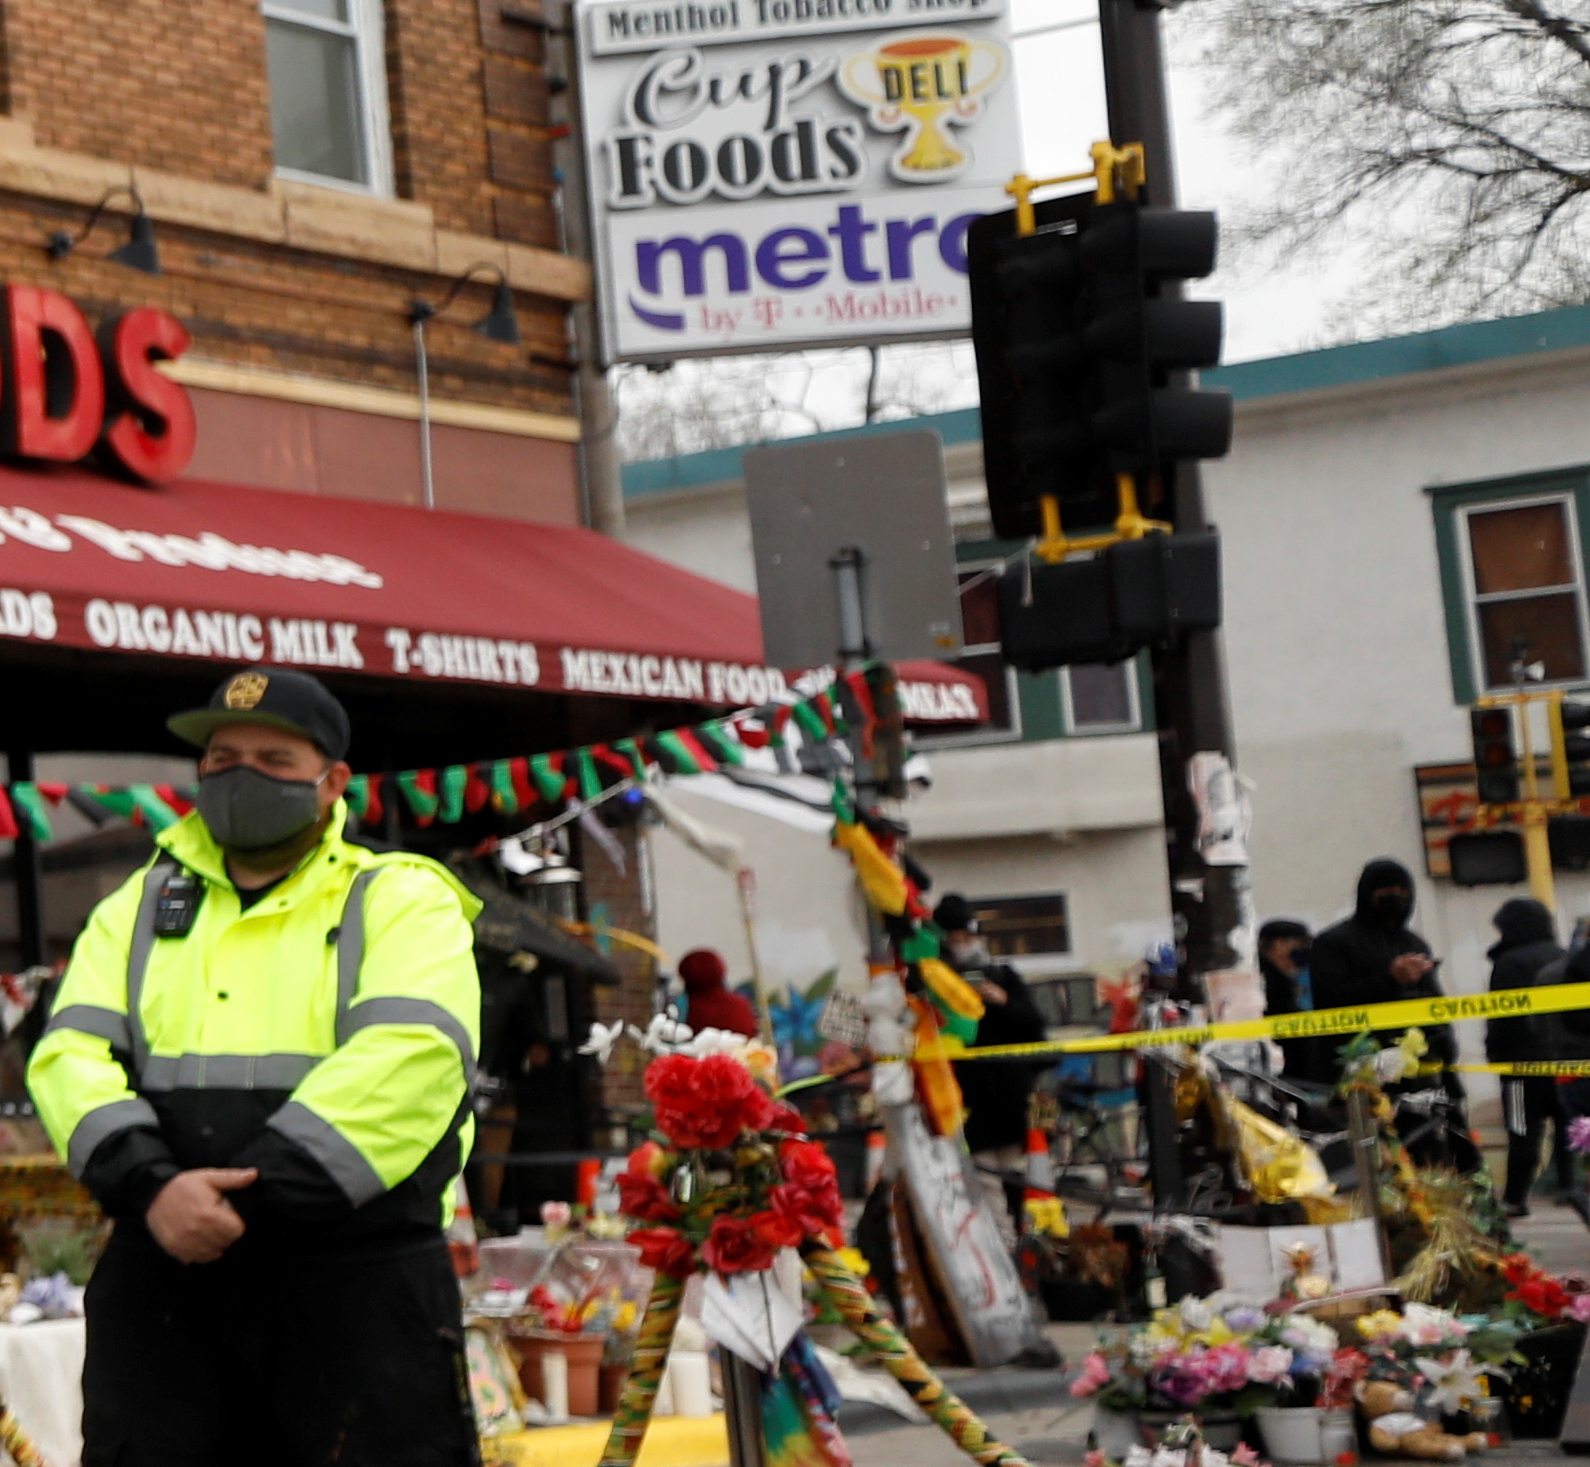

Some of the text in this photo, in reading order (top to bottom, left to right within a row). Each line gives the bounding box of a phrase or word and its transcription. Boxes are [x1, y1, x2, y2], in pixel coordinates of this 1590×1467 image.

[608, 0, 740, 39] Menthol
[633, 49, 833, 131] Cup
[883, 59, 967, 102] DELI
[615, 120, 861, 198] Foods
[86, 597, 265, 663] ORGANIC
[271, 617, 365, 670] MILK
[385, 630, 540, 687] T-SHIRTS
[561, 644, 704, 702] MEXICAN
[706, 660, 788, 708] FOOD
